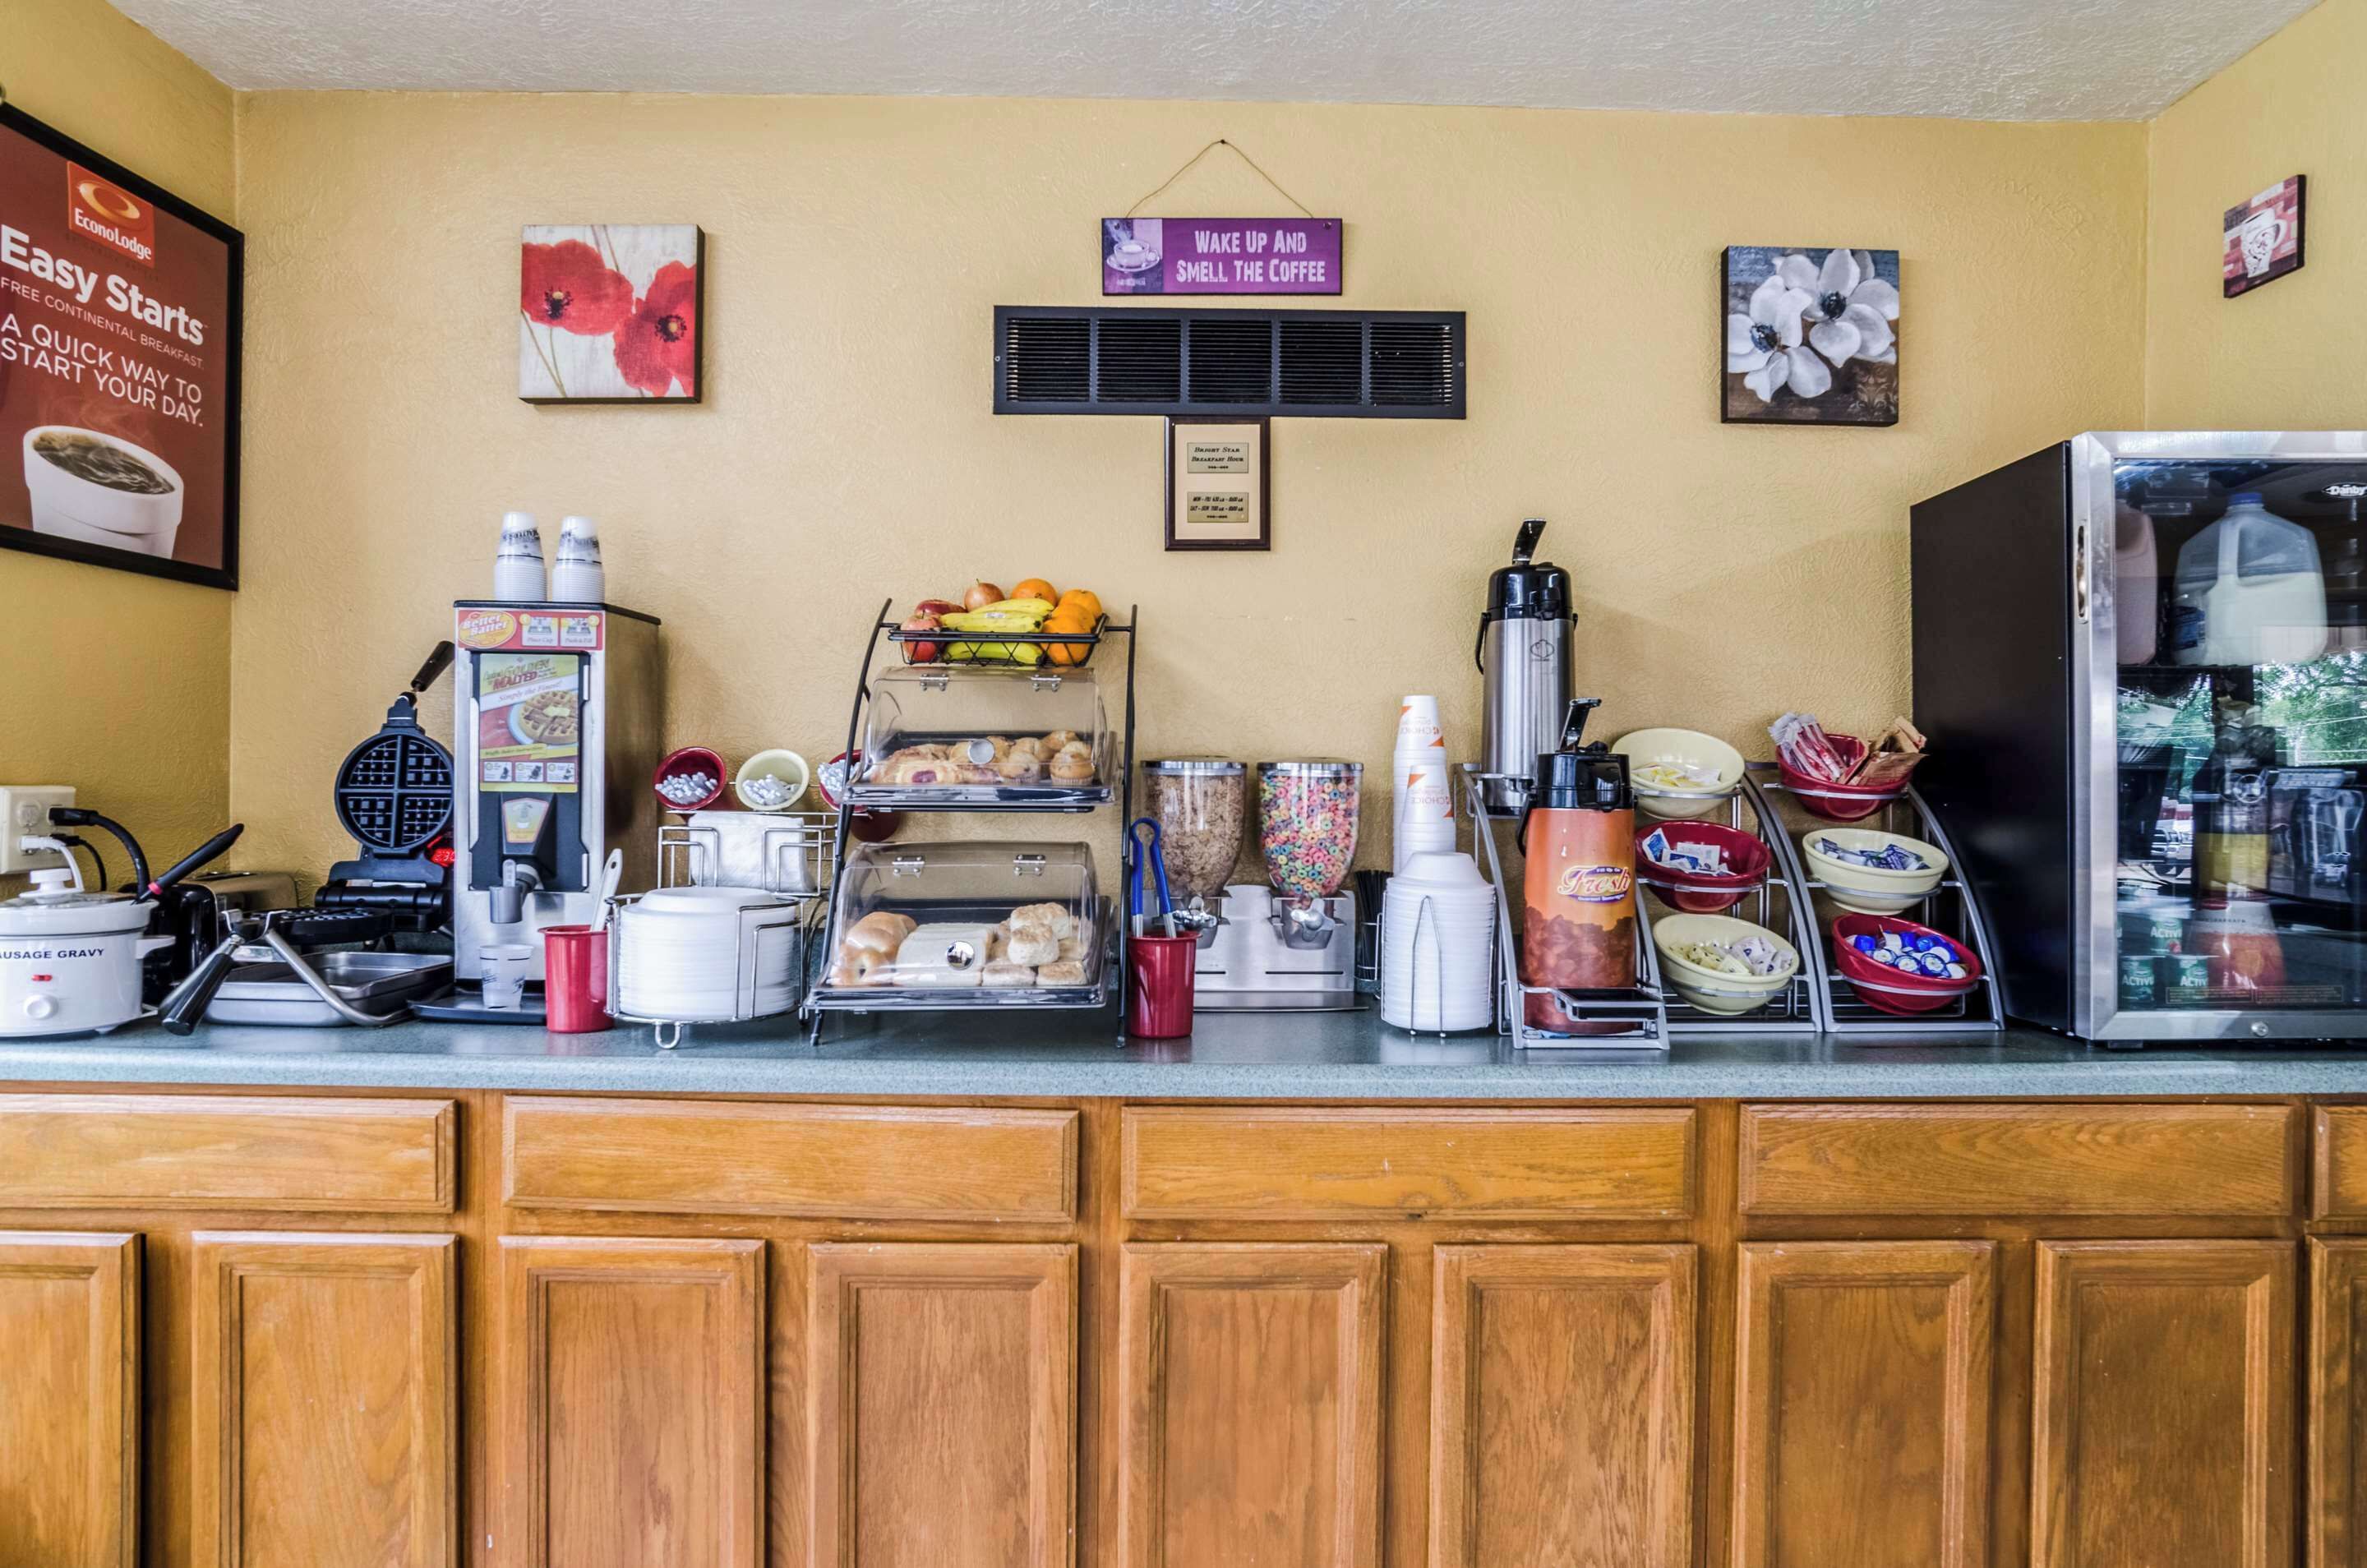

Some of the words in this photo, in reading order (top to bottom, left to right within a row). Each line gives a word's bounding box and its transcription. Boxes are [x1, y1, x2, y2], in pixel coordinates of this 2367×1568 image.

[74, 207, 152, 261] EconoLodge
[1194, 230, 1240, 254] WAKE
[1, 224, 99, 304] Easy
[105, 274, 204, 346] Starts
[1175, 259, 1229, 284] SMELL
[1234, 260, 1264, 283] THE
[1268, 258, 1326, 283] COFFEE
[1, 276, 40, 303] FREE
[44, 295, 137, 342] CONTINENTAL
[1, 312, 21, 338] A
[31, 323, 113, 371] QUICK
[120, 355, 170, 392] WAY
[175, 377, 202, 404] TO
[1, 337, 85, 384] START
[94, 369, 156, 410] YOUR
[162, 395, 204, 427] DAY.
[1557, 865, 1631, 895] Fresh
[2150, 926, 2183, 938] ACTIVI
[57, 948, 104, 959] GRAVY
[2122, 975, 2155, 986] ACTIVI
